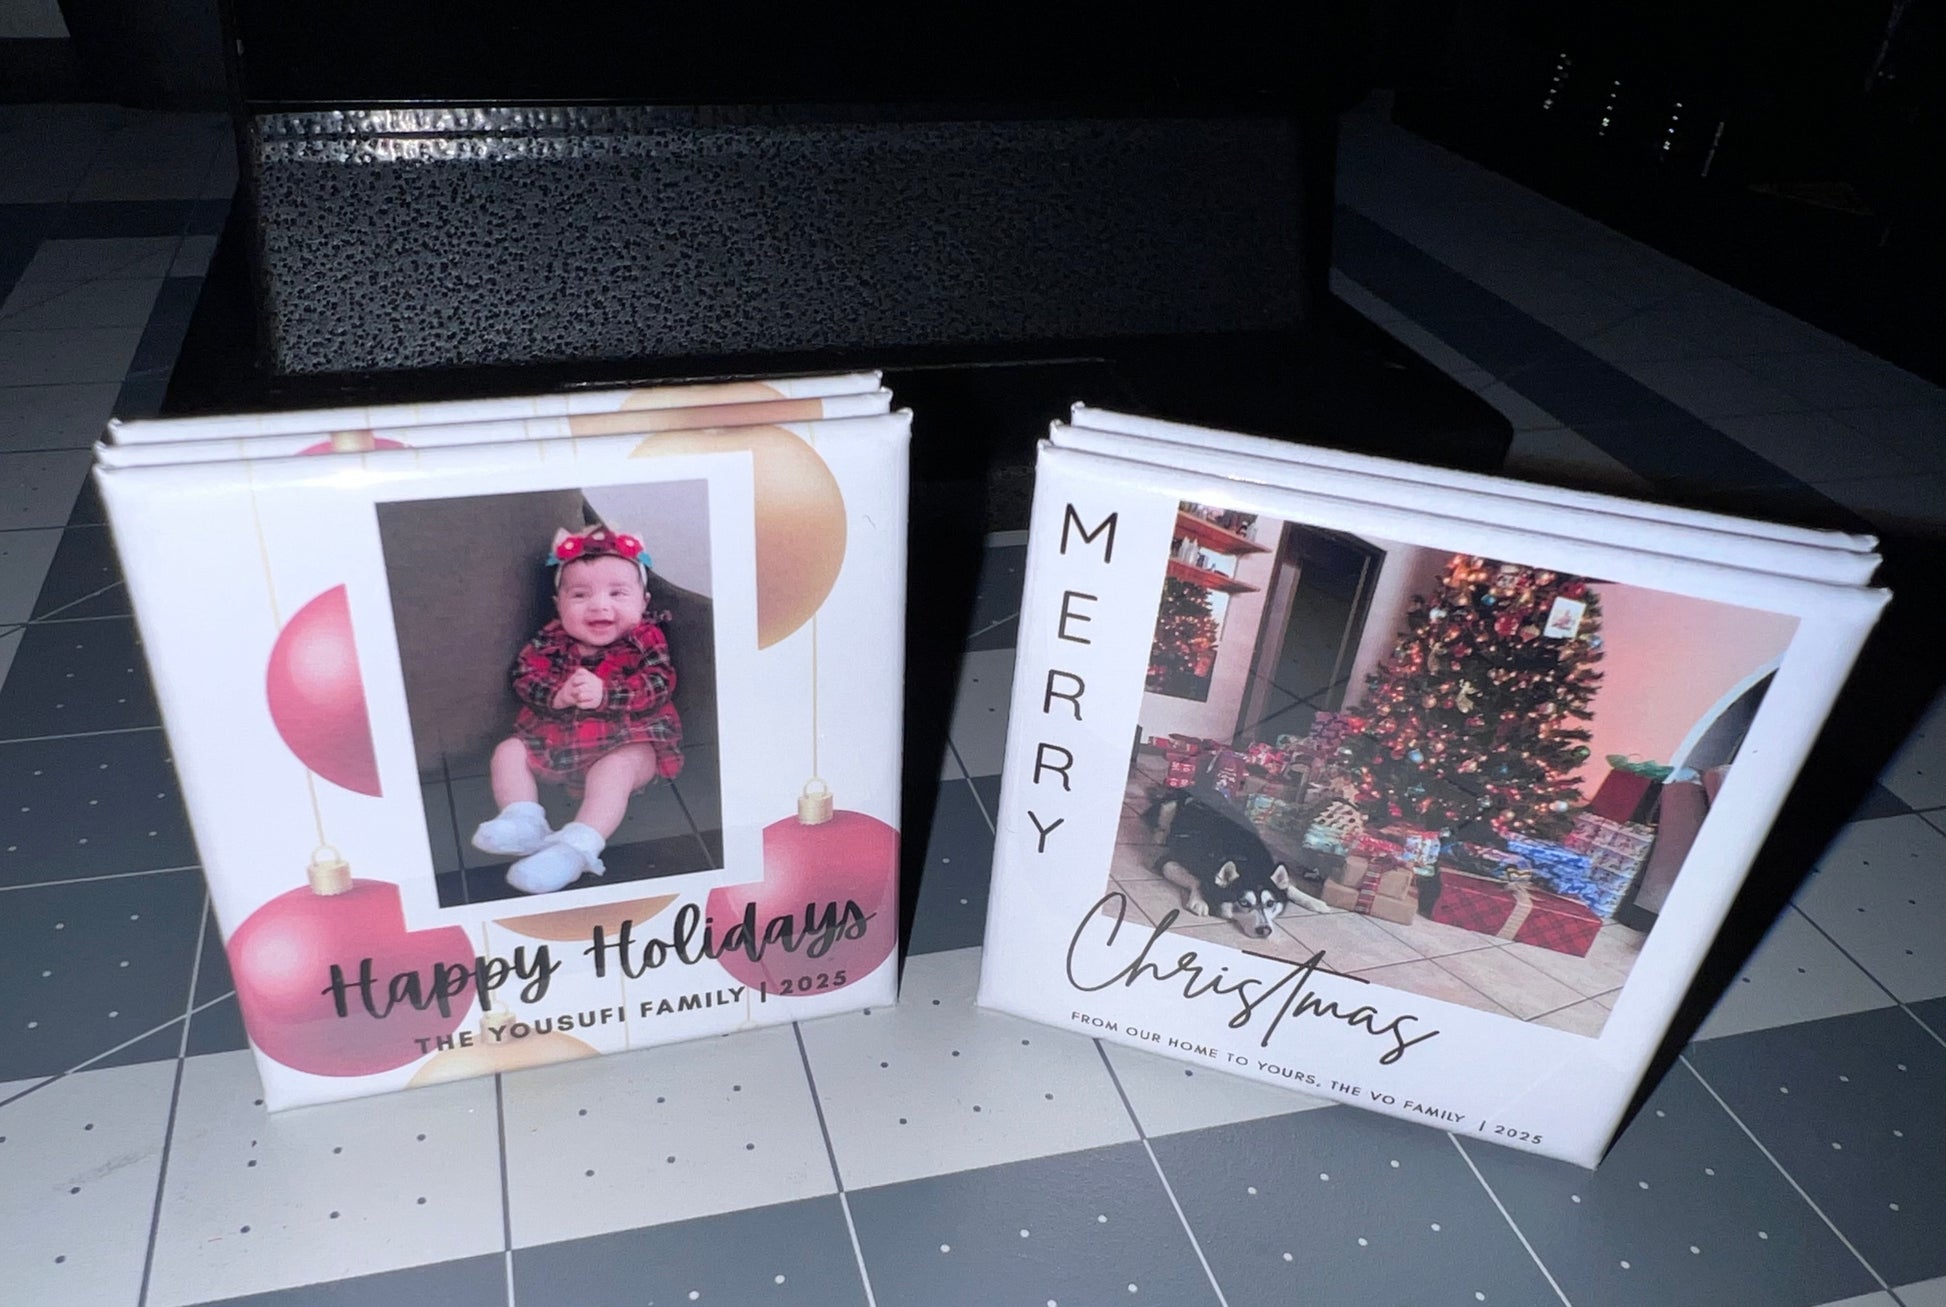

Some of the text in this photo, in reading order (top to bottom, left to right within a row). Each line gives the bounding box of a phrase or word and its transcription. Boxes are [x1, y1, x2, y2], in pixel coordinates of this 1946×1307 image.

[1027, 502, 1119, 854] MERRY
[321, 899, 877, 1019] Happy Holidays
[414, 1031, 474, 1055] THE
[488, 1007, 626, 1042] YOUSUFI
[640, 986, 745, 1018] FAMILY
[780, 970, 847, 996] 2025
[1066, 890, 1440, 1066] Christmas
[1071, 1011, 1118, 1032] FROM
[1126, 1026, 1161, 1044] OUR
[1168, 1037, 1218, 1059] HOME
[1227, 1052, 1249, 1067] TO
[1330, 1080, 1361, 1097] THE
[1370, 1091, 1395, 1105] VO
[1403, 1100, 1466, 1123] FAMILY
[1494, 1124, 1543, 1145] 2025
